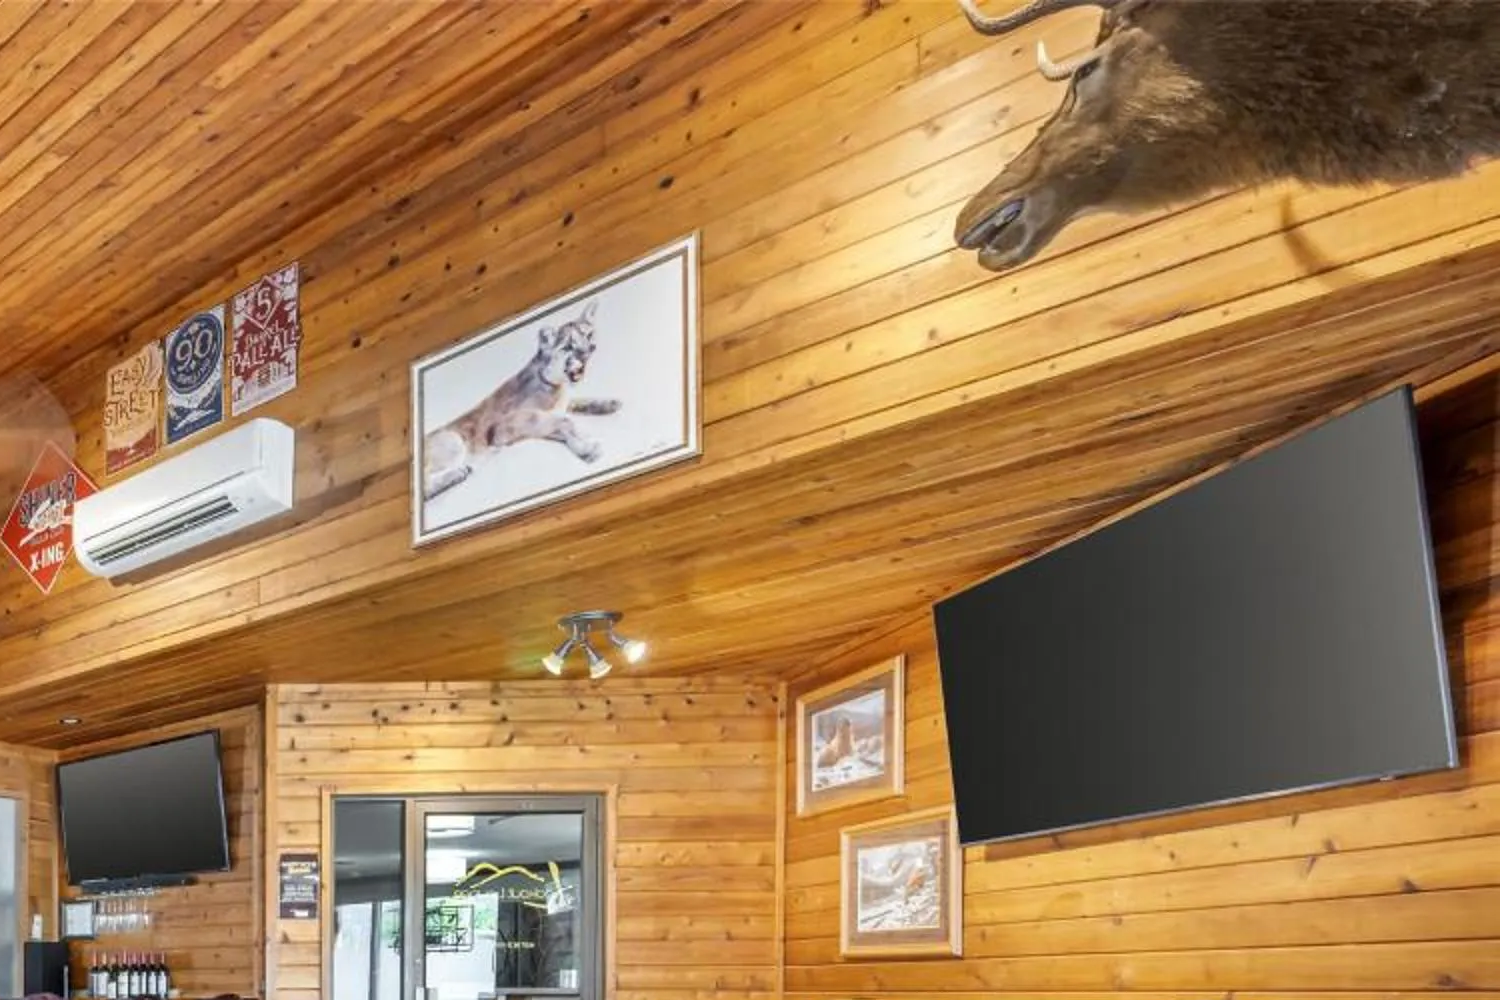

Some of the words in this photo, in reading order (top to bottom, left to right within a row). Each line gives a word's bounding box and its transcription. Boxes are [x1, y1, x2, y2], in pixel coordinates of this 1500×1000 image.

[255, 287, 272, 321] 5
[175, 328, 213, 372] 90
[270, 325, 301, 357] ALE
[110, 355, 149, 396] EASY
[104, 390, 160, 427] STREET
[28, 541, 65, 573] X-ING
